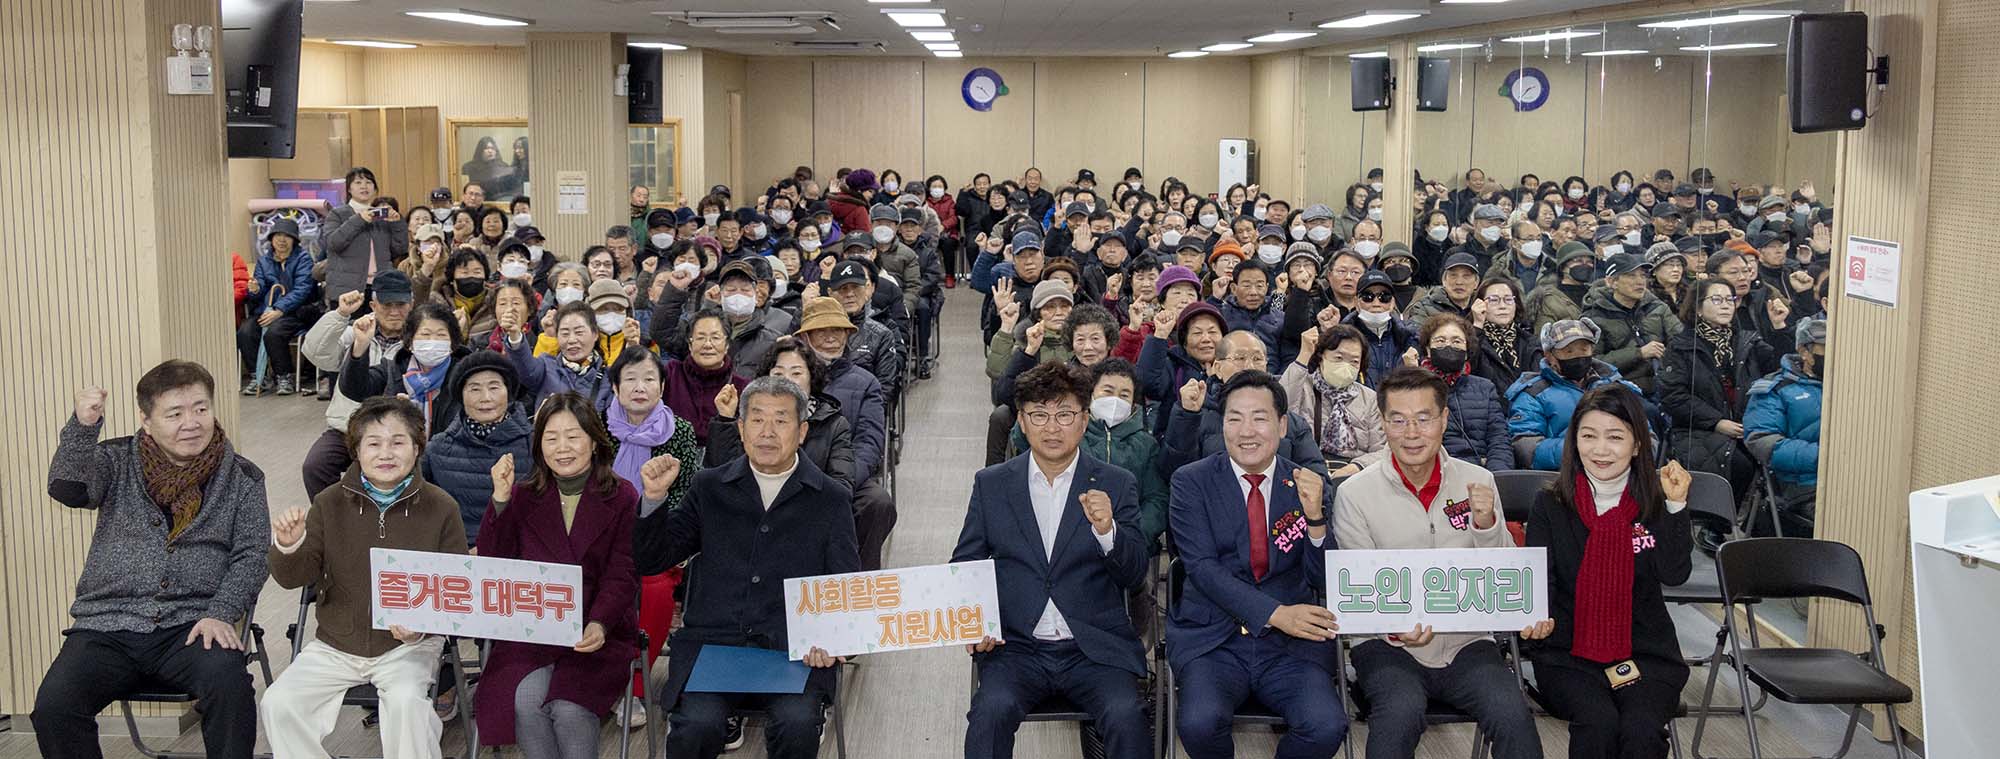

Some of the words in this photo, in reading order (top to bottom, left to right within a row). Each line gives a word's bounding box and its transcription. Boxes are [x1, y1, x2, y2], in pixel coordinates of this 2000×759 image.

[378, 570, 474, 614] 즐거운
[480, 578, 576, 622] 대덕구
[796, 574, 901, 616] 사회활동
[1338, 567, 1412, 614] 노인
[1422, 566, 1533, 614] 일자리
[878, 604, 985, 648] 지원사업
